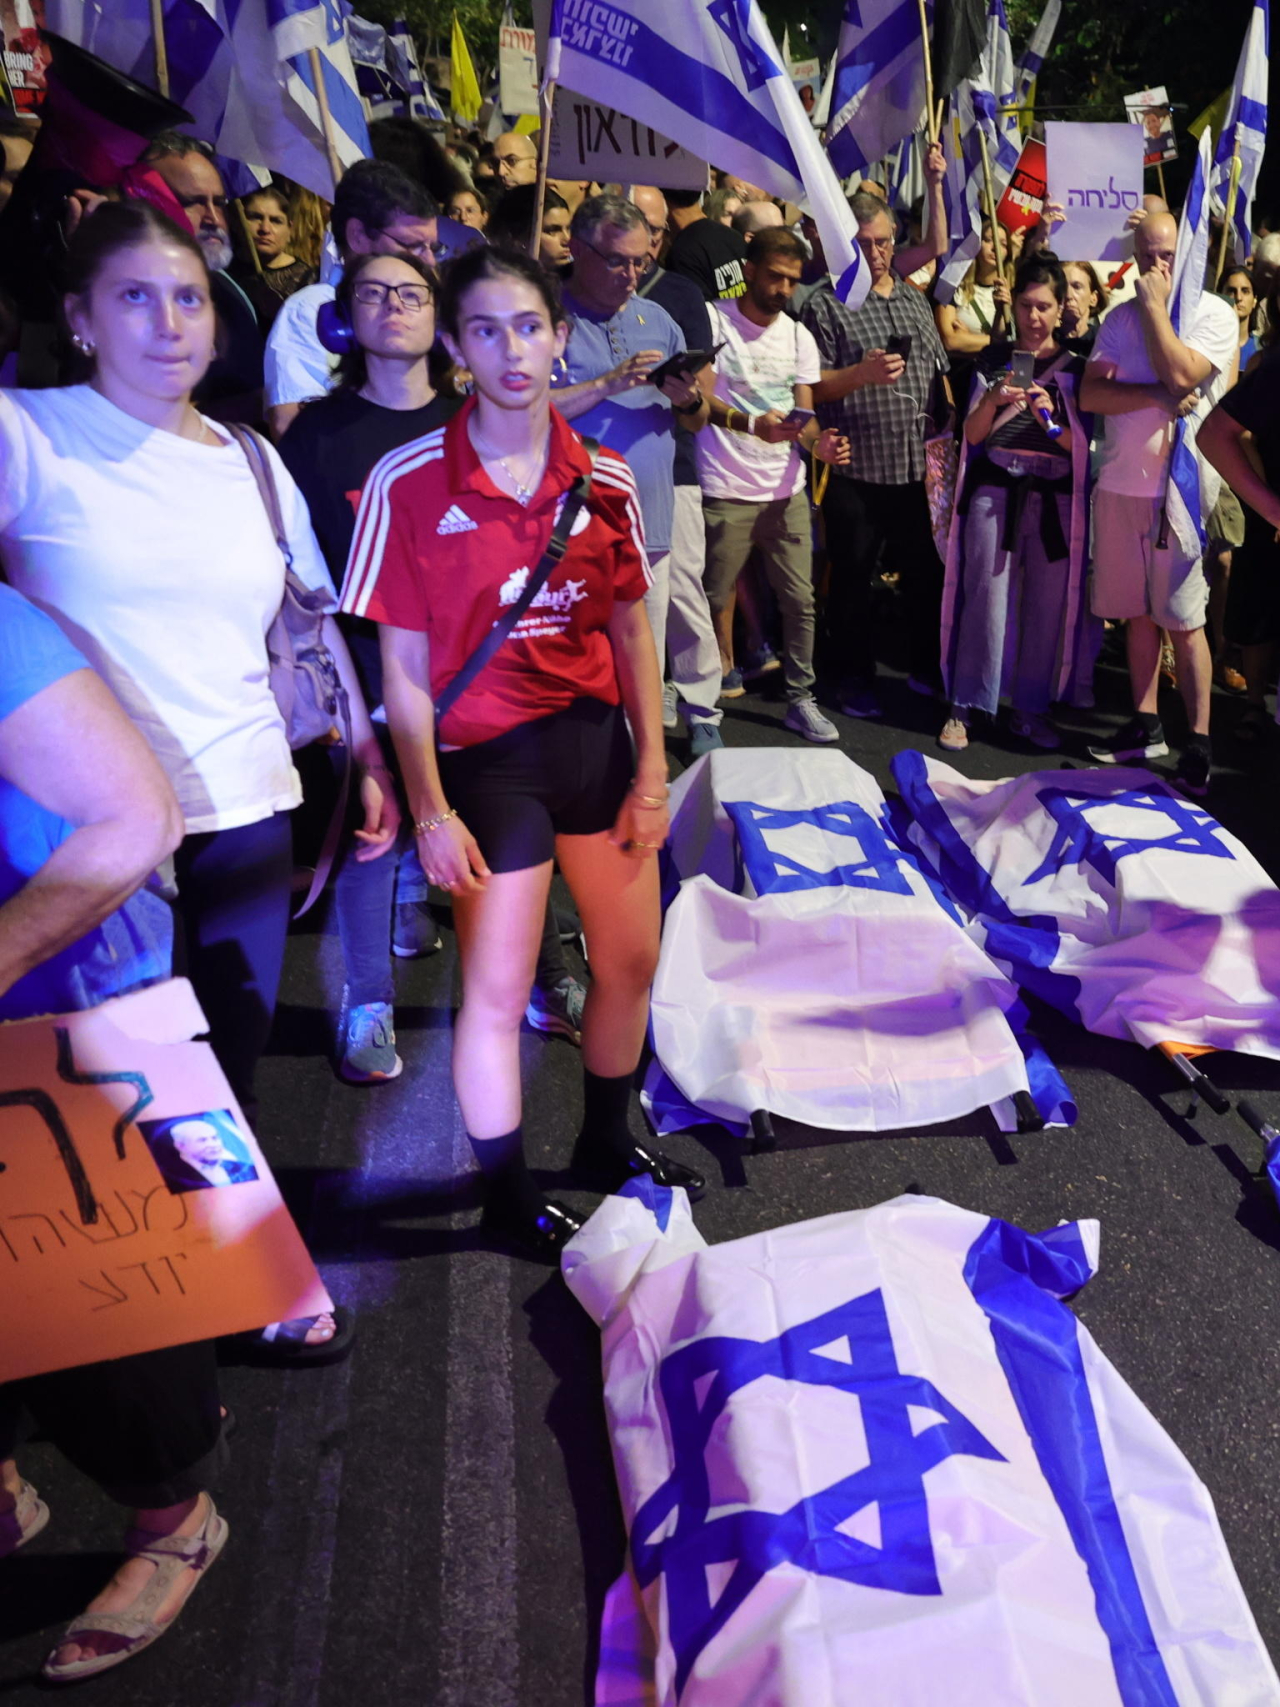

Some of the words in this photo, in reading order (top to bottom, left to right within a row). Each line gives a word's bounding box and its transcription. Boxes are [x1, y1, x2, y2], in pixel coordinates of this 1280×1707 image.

[3, 50, 34, 71] BRING
[8, 70, 25, 87] HER
[1068, 176, 1139, 211] סליחה
[436, 521, 478, 534] adidas
[79, 1252, 188, 1312] יודע
